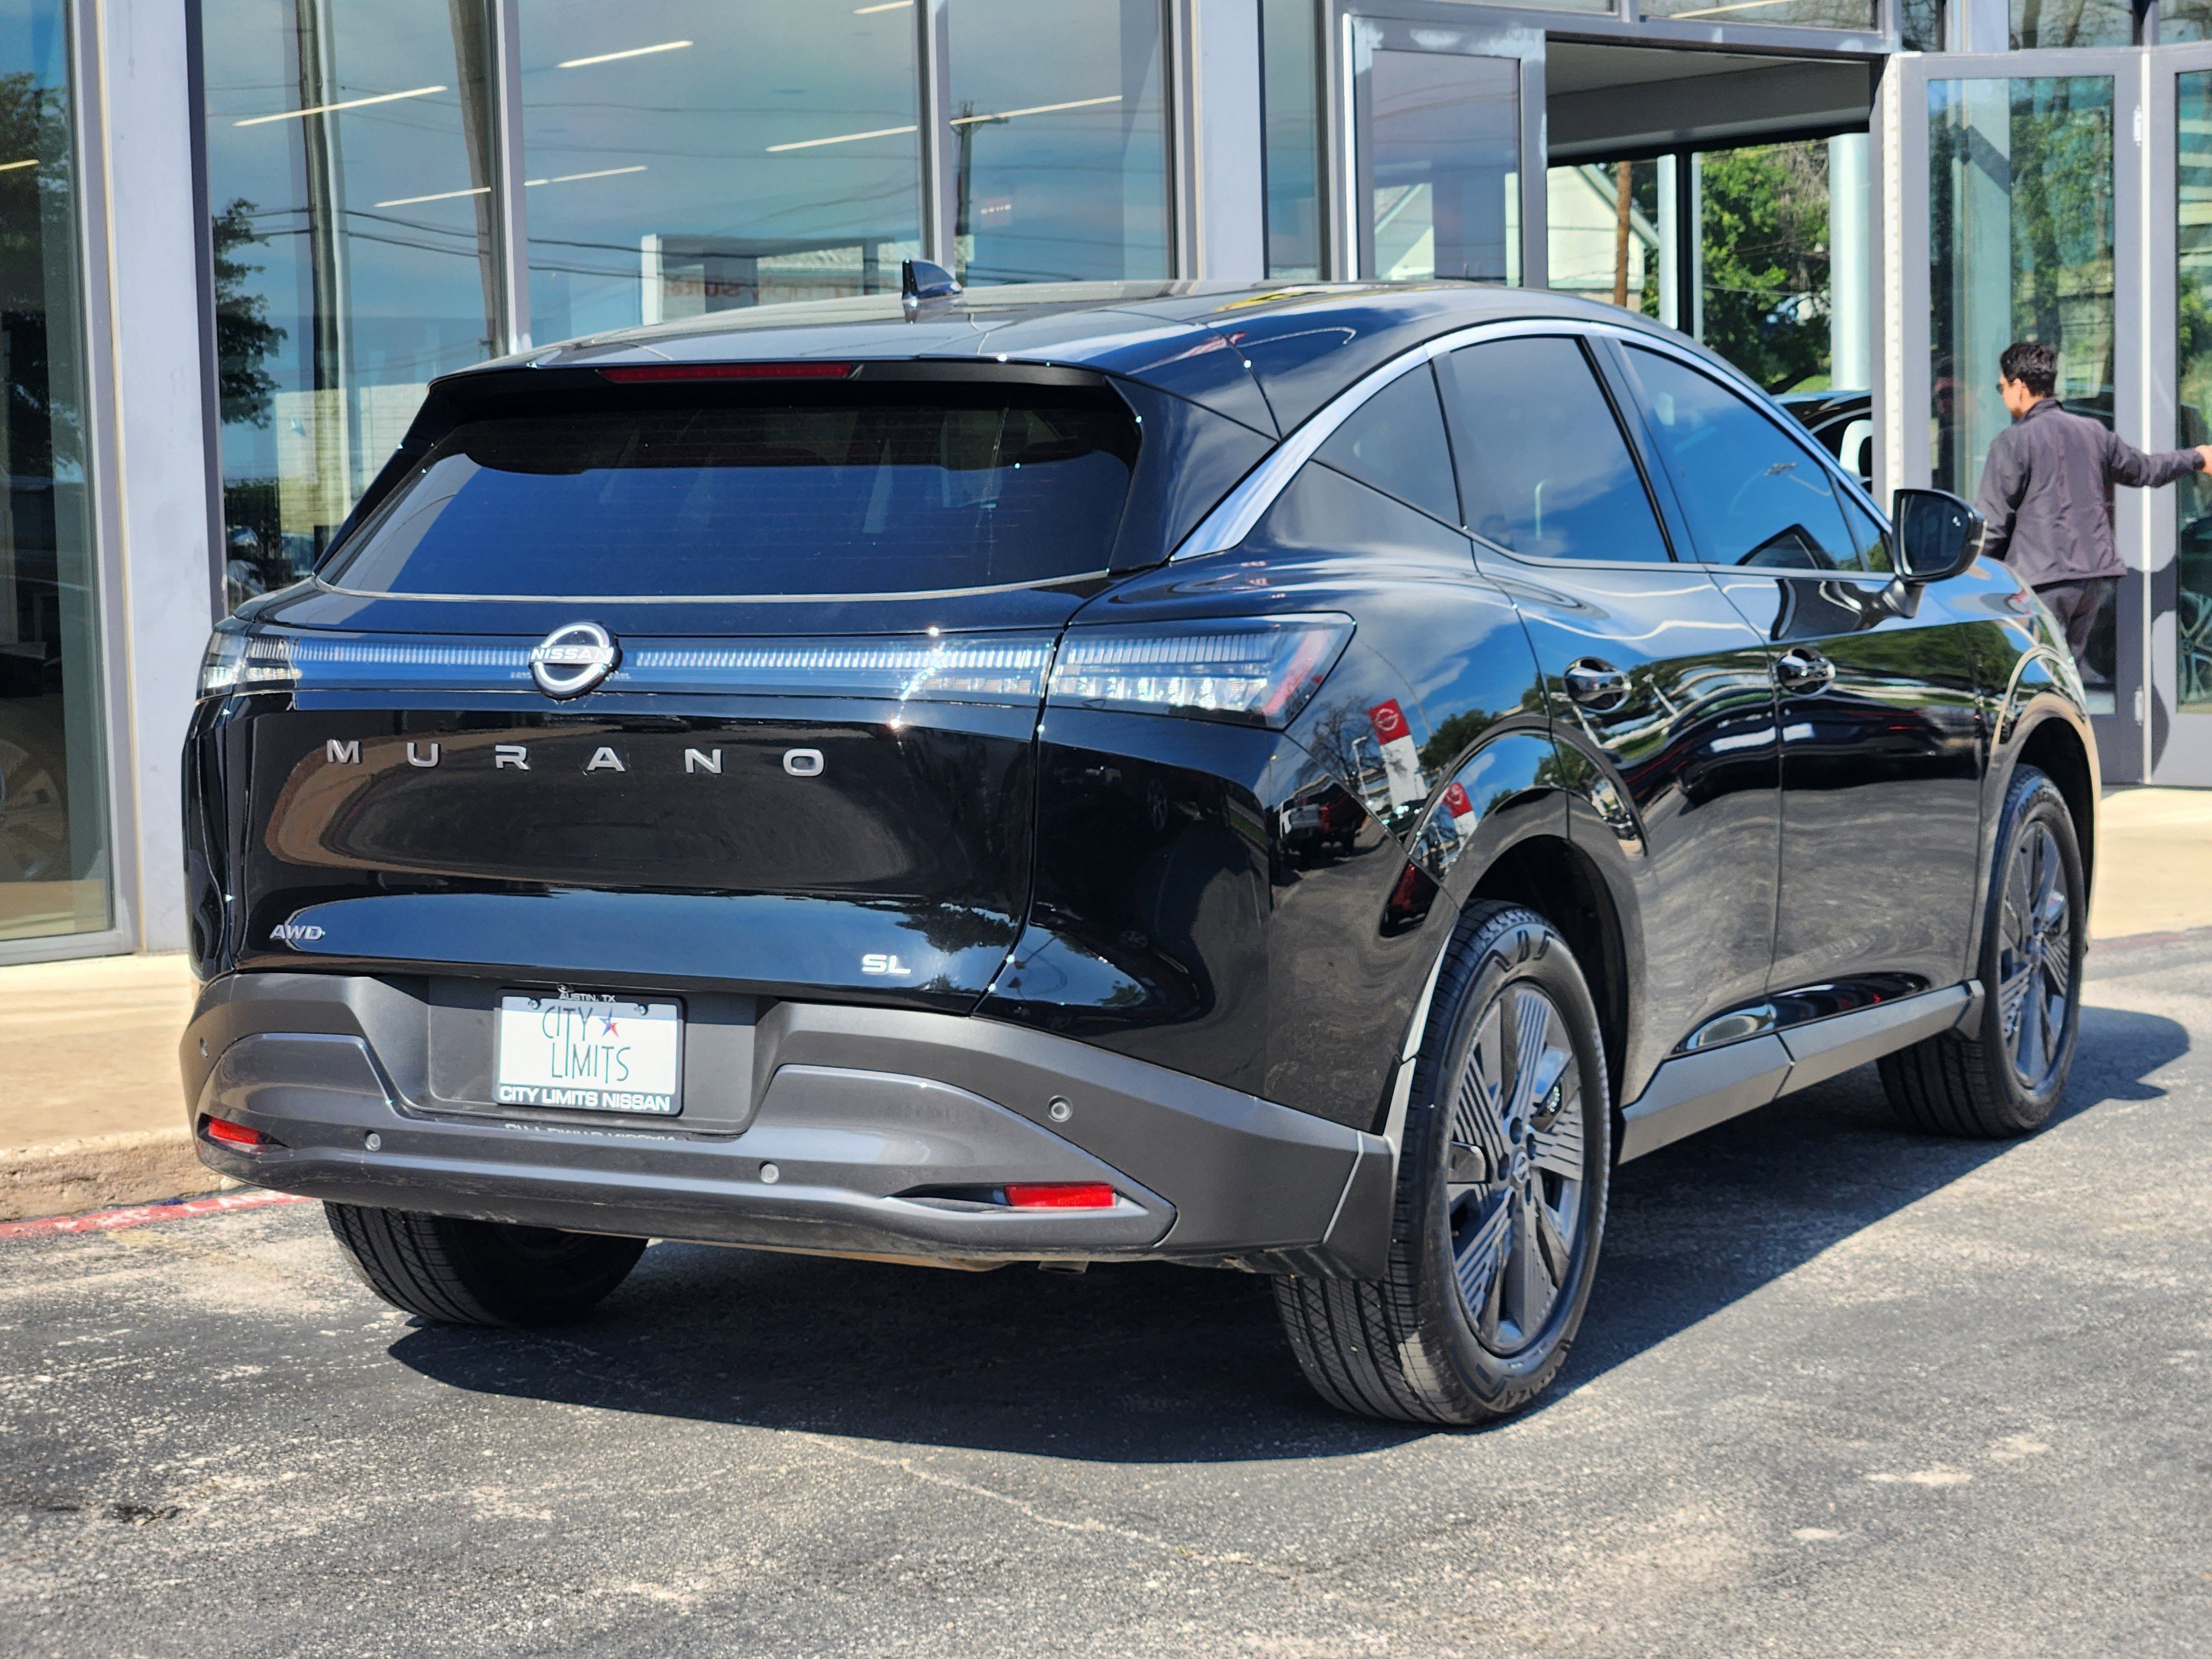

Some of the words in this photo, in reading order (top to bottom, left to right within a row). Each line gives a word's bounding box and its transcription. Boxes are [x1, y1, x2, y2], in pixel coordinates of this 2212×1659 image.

[531, 648, 614, 664] NISSAN
[326, 738, 825, 776] MURANO
[269, 924, 324, 940] AWD
[862, 954, 912, 974] SL
[559, 992, 599, 1002] AUSTIN,
[601, 994, 617, 1003] TX
[542, 1005, 593, 1041] CITY
[552, 1042, 632, 1084] LIMITS
[499, 1086, 540, 1103] CITY
[541, 1088, 598, 1107] LIMITS
[602, 1092, 670, 1112] NISSAN
